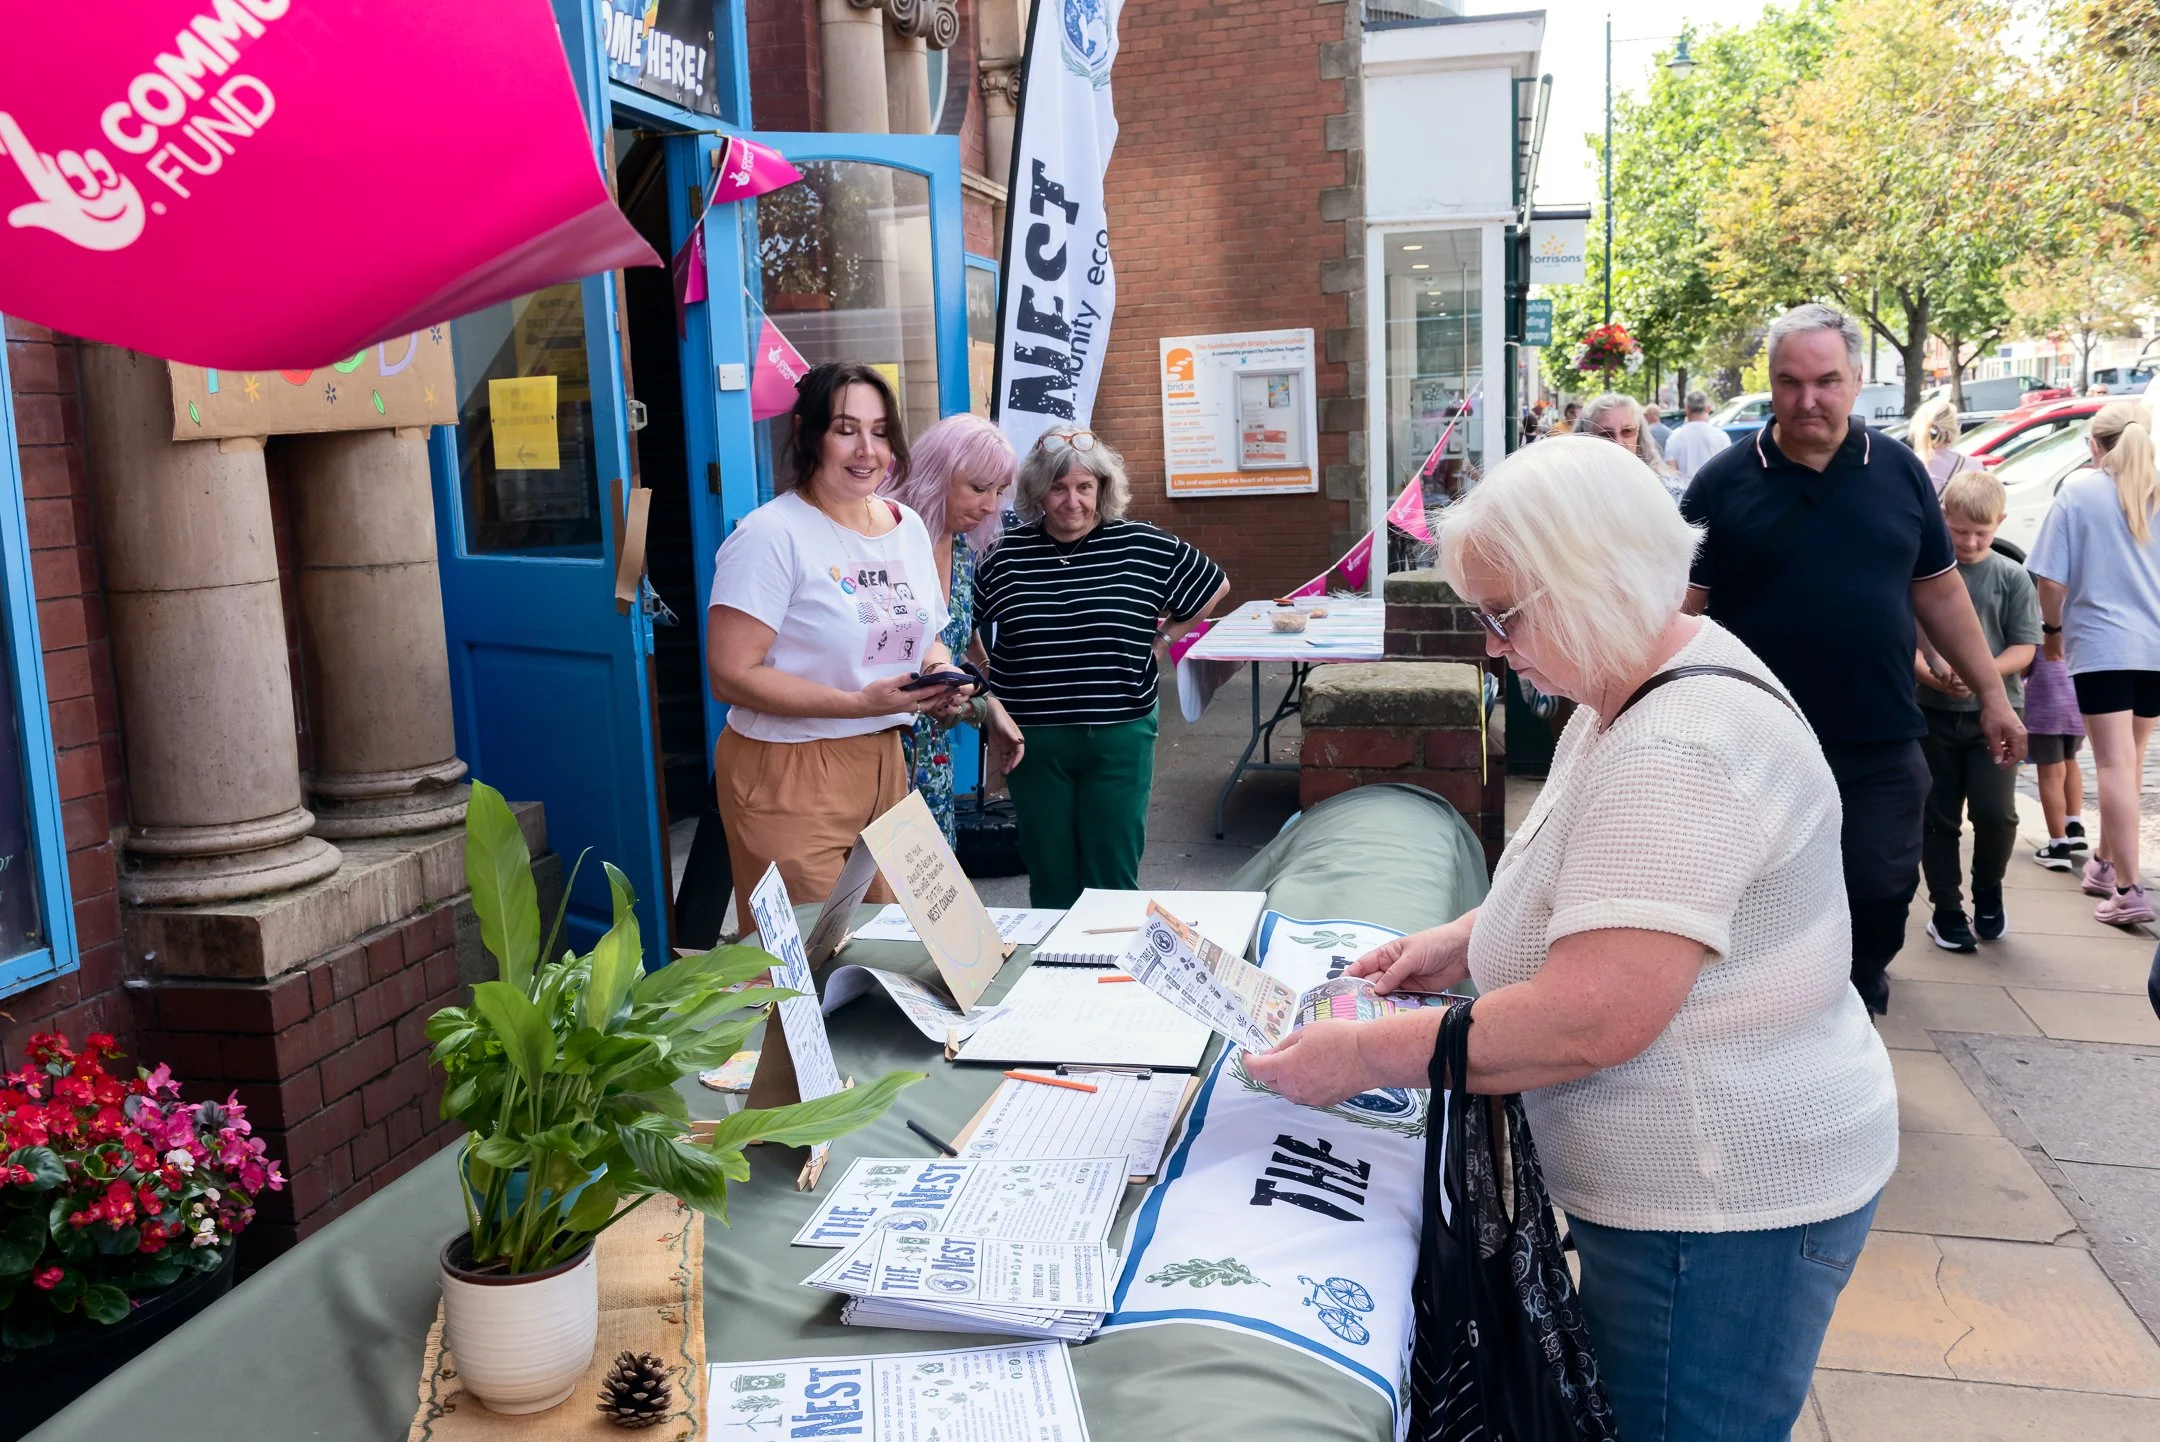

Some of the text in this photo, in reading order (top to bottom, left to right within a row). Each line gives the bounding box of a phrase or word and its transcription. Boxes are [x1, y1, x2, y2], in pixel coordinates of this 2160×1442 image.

[602, 0, 706, 96] OME HERE!
[100, 0, 291, 154] COMM
[145, 74, 276, 199] FUND
[1087, 229, 1108, 286] eco
[1526, 316, 1546, 329] ding
[1527, 302, 1550, 313] shire
[1248, 338, 1268, 348] Bridge
[1525, 332, 1550, 343] pany
[1199, 478, 1221, 487] support
[1275, 474, 1309, 483] community
[755, 897, 777, 951] THE
[926, 903, 942, 925] NEST
[888, 1163, 969, 1209] NEST
[1250, 1133, 1371, 1222] THE
[809, 1205, 879, 1239] THE
[930, 1237, 976, 1273] NEST
[881, 1265, 921, 1292] THE
[1033, 1278, 1043, 1298] TOGETHER
[881, 1370, 889, 1397] Guisborough
[789, 1364, 866, 1438] NEST
